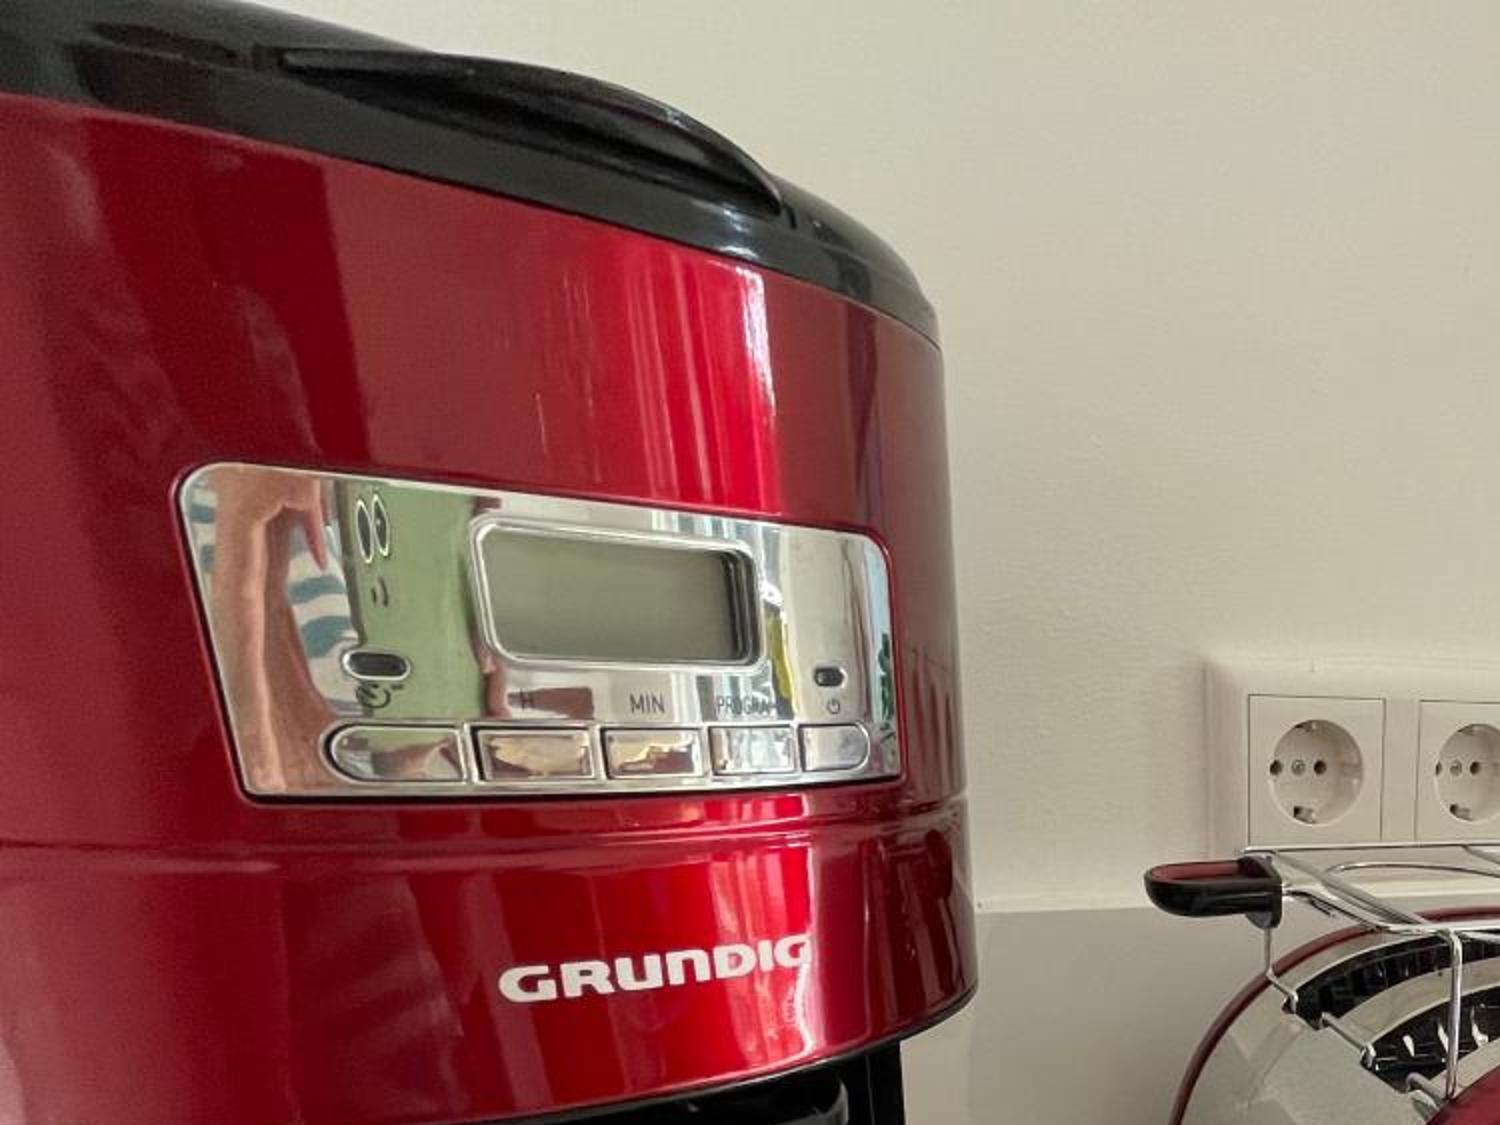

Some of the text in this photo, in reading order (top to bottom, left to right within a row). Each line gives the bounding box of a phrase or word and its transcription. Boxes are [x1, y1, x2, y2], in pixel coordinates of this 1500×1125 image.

[629, 693, 666, 715] MIN
[717, 695, 783, 716] PROGRA
[498, 932, 813, 1002] GRUNDIG
